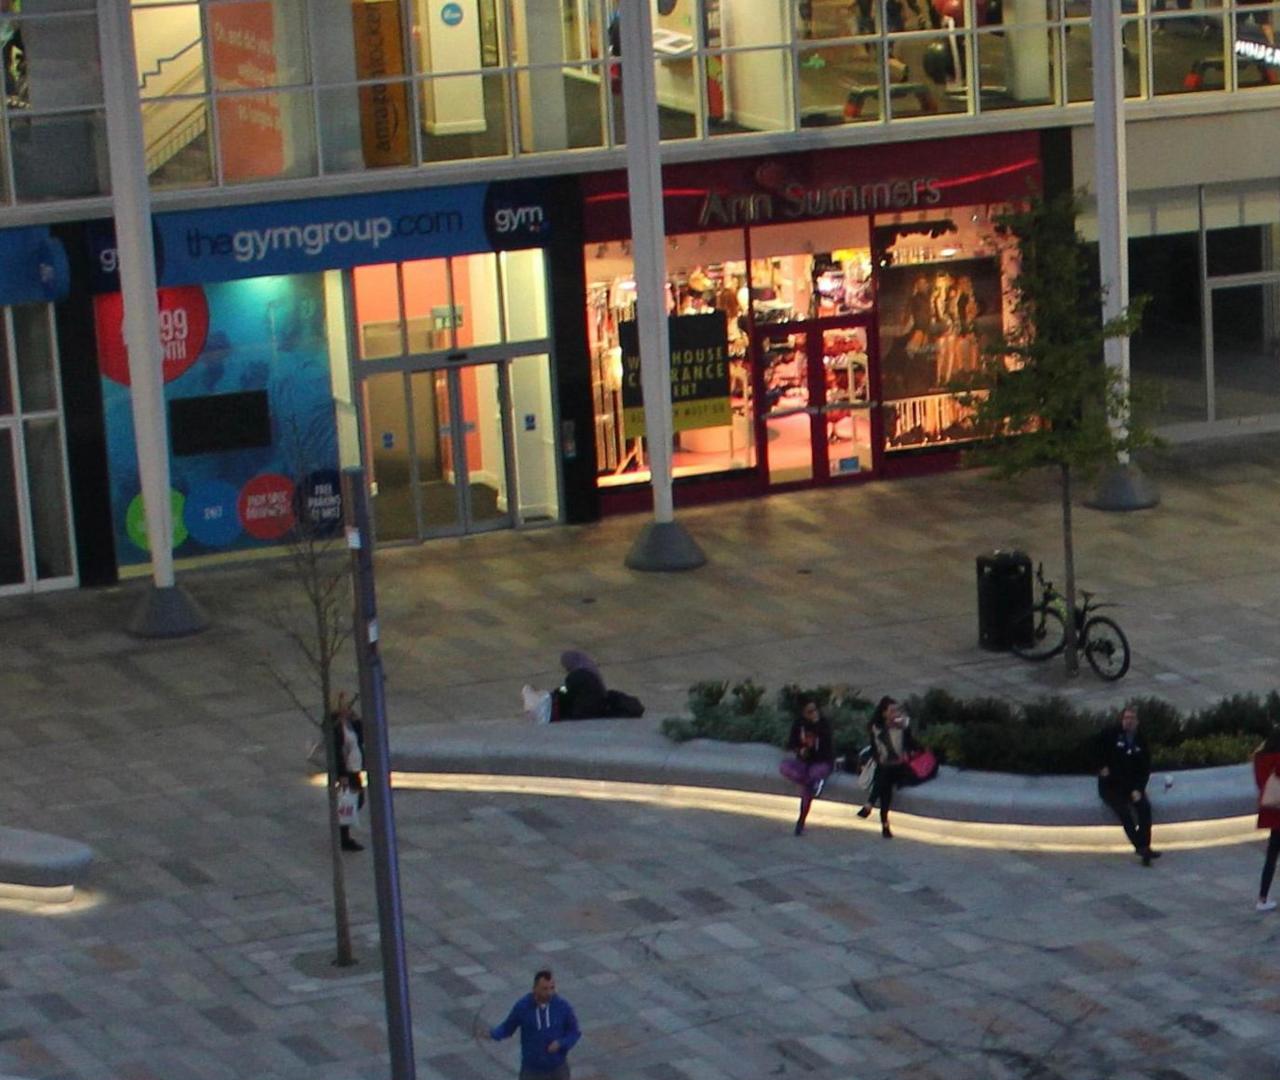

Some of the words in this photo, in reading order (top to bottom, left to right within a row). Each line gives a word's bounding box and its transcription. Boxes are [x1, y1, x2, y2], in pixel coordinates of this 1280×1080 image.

[494, 205, 544, 233] gym
[700, 190, 772, 226] Ann
[786, 178, 941, 217] Summers
